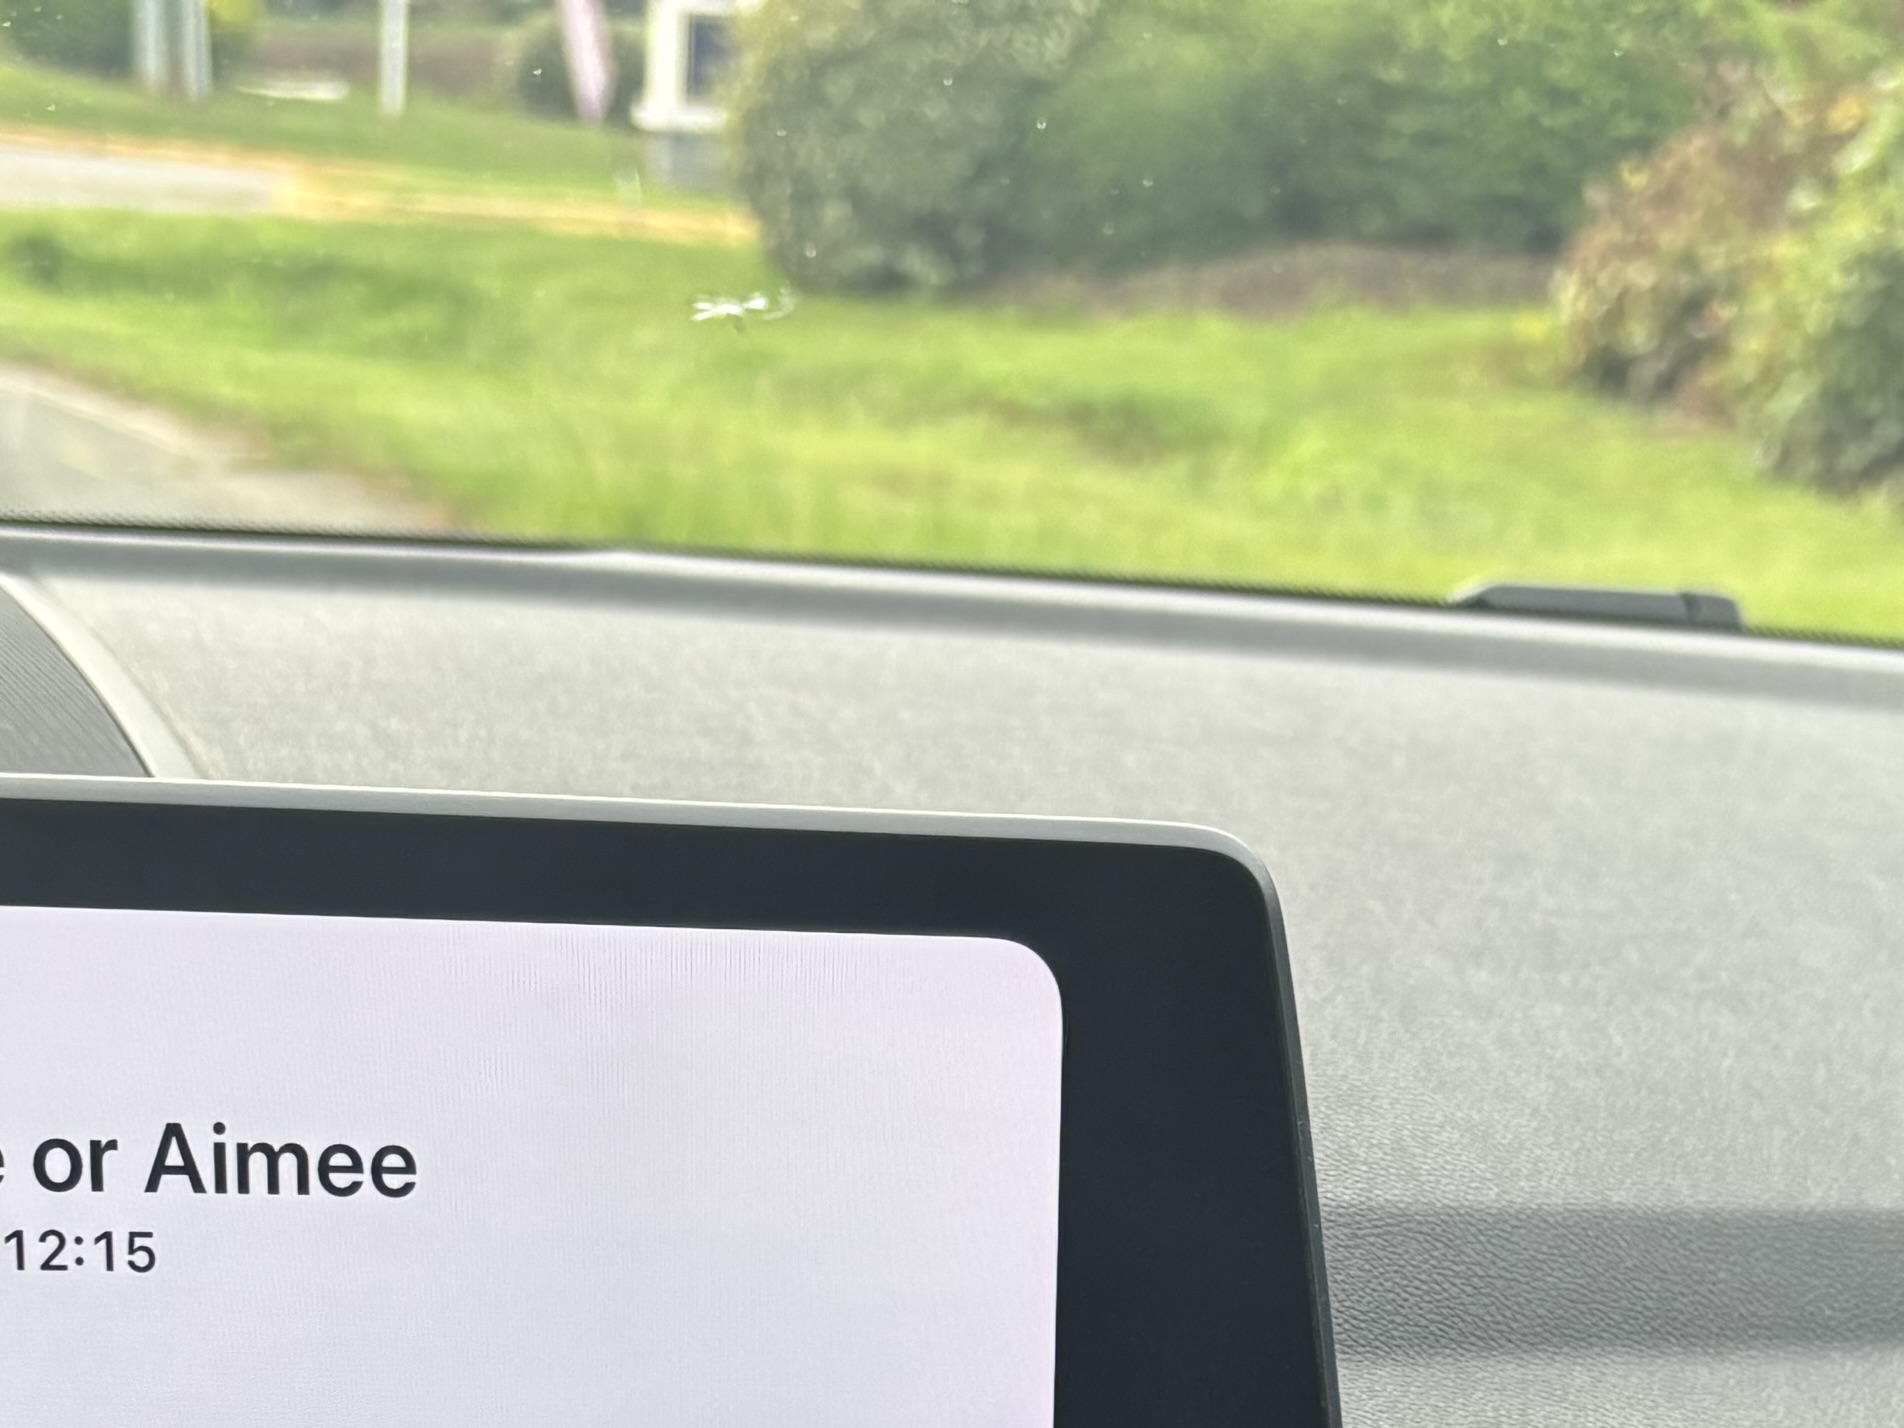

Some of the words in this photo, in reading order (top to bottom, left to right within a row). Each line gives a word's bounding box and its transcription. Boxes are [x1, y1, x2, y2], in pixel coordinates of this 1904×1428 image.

[32, 1138, 118, 1193] or
[144, 1121, 417, 1198] Aimee
[4, 1229, 156, 1273] 12:15
